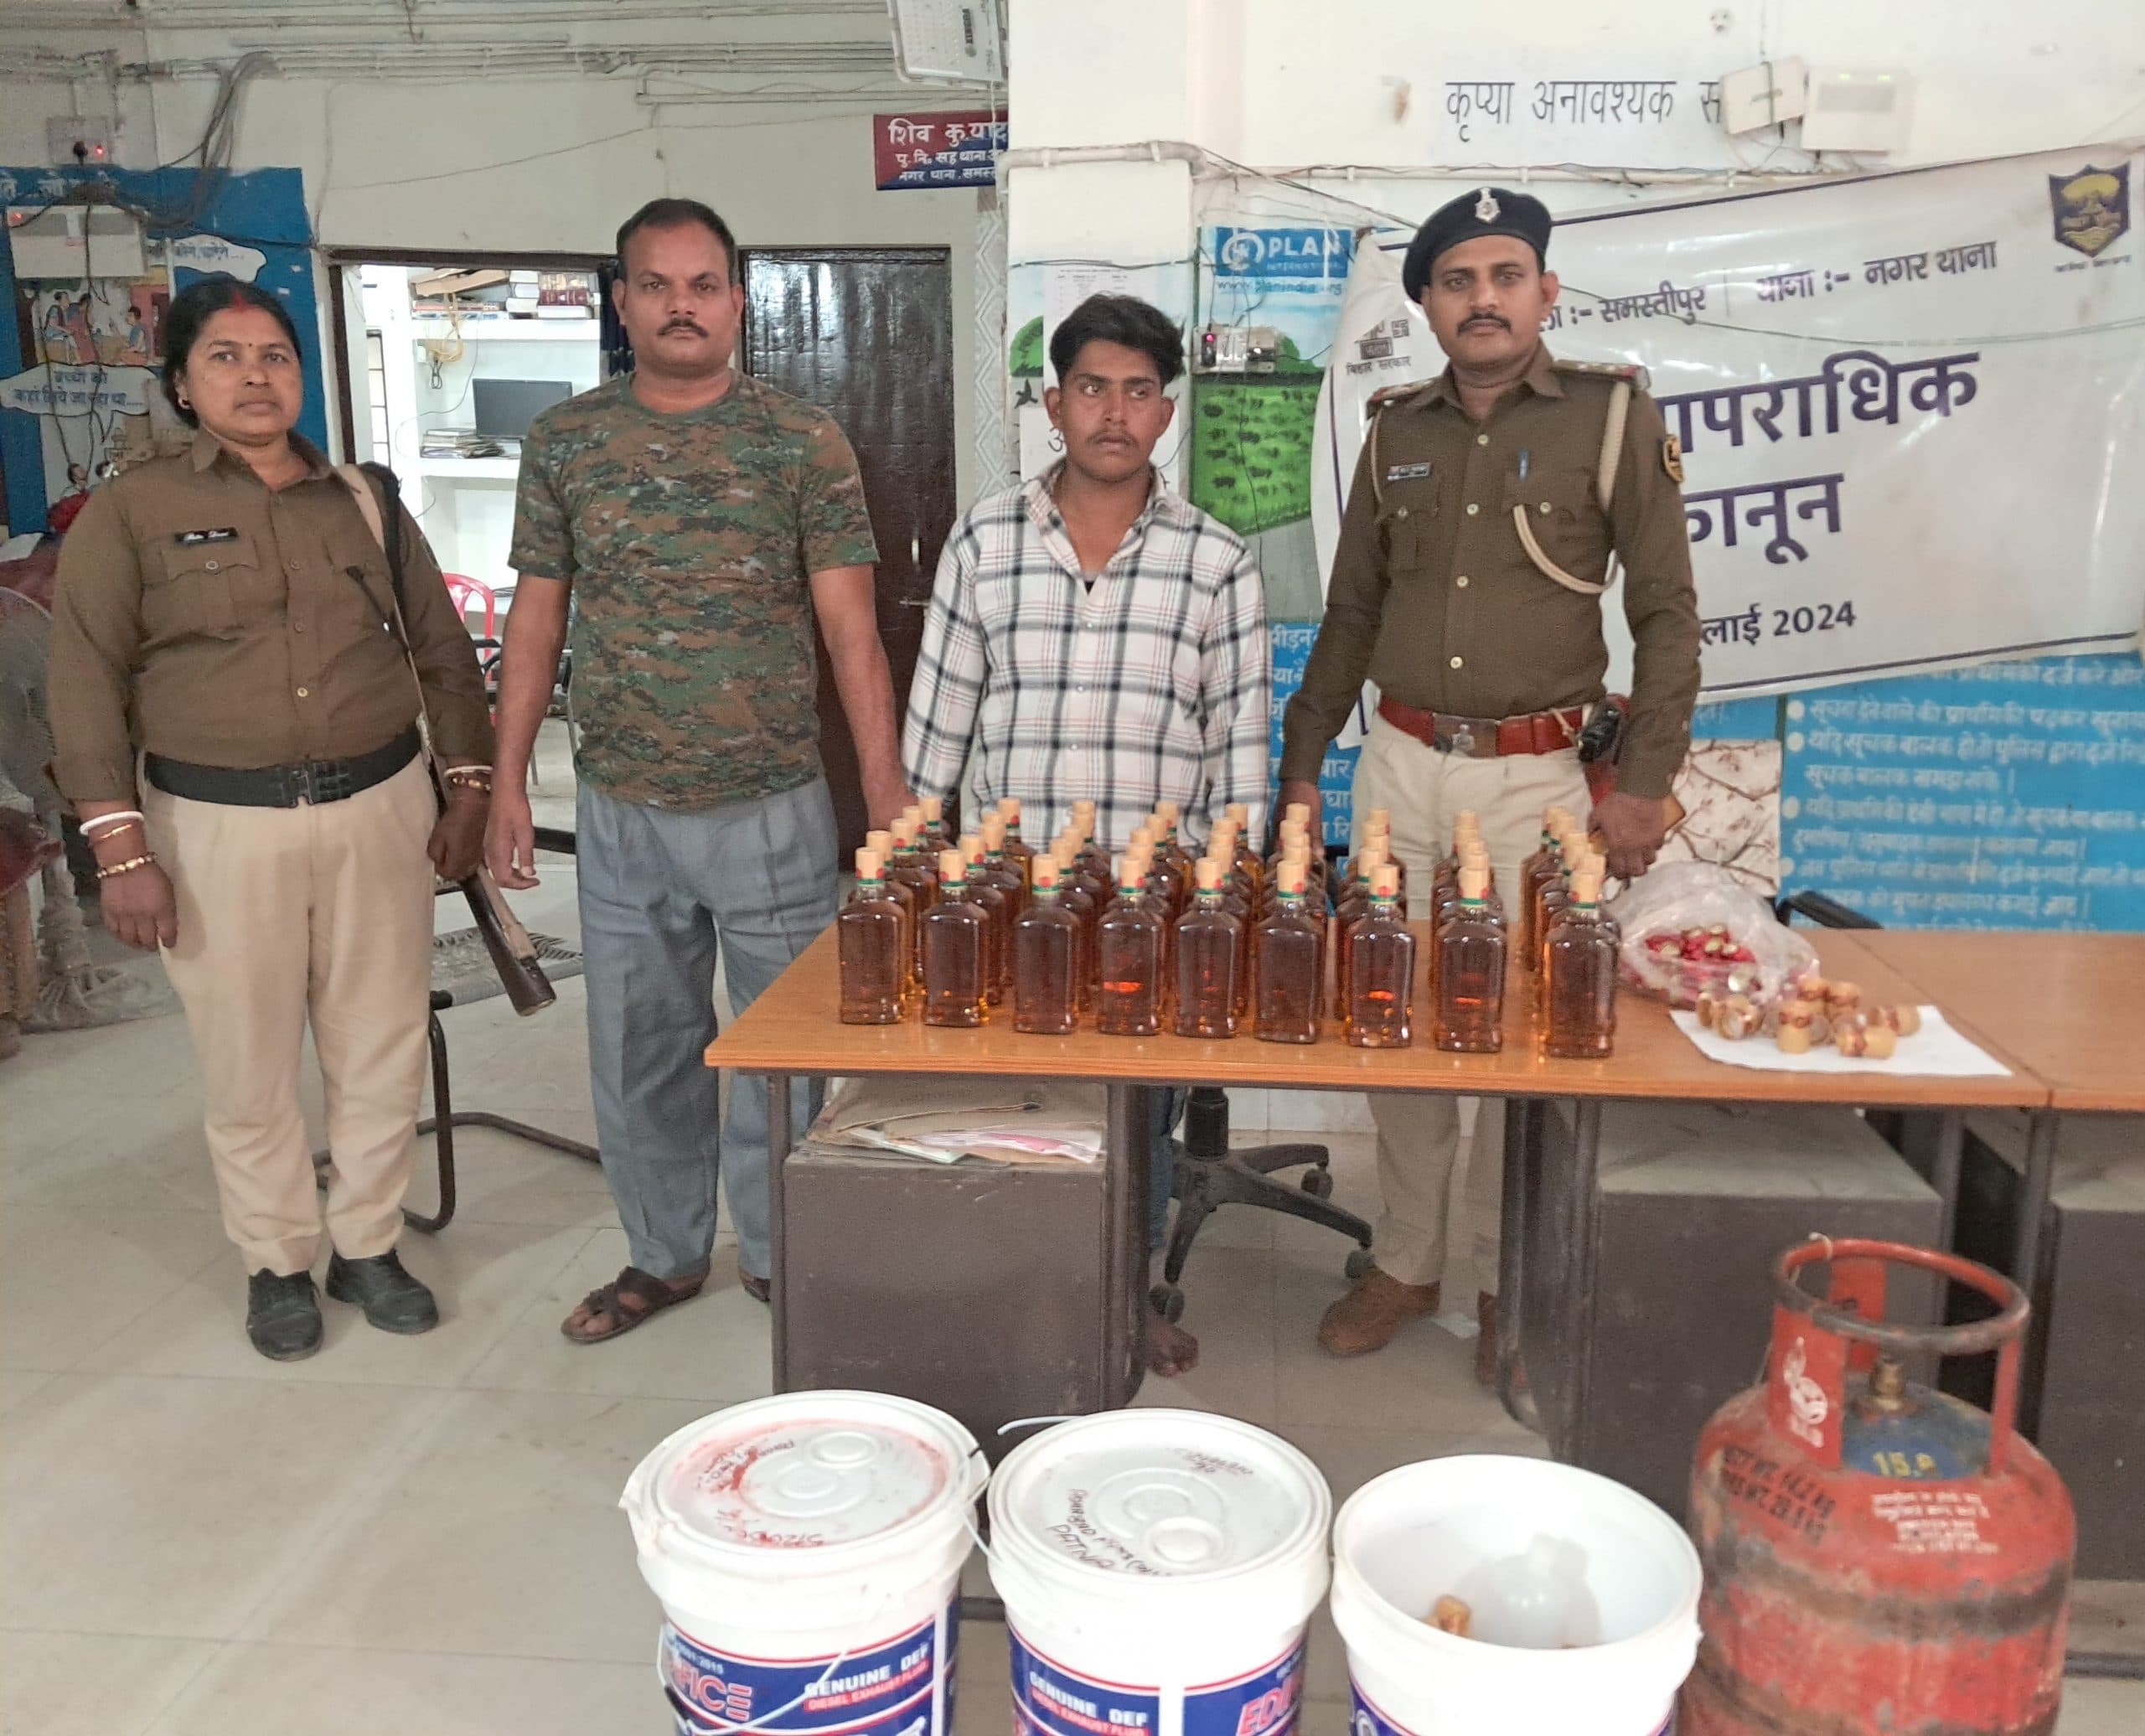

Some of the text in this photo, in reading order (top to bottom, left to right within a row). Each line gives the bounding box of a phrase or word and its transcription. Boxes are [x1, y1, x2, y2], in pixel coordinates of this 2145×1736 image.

[1531, 81, 1677, 124] अनावश्यक
[887, 117, 935, 146] शिव
[1268, 230, 1341, 258] PLAN
[1599, 280, 1707, 326] समस्तीपुर
[1863, 251, 1930, 286] नगर
[1772, 600, 1857, 637] 2024
[804, 1642, 929, 1698] GENUINE DEF
[1109, 1708, 1148, 1728] DEF
